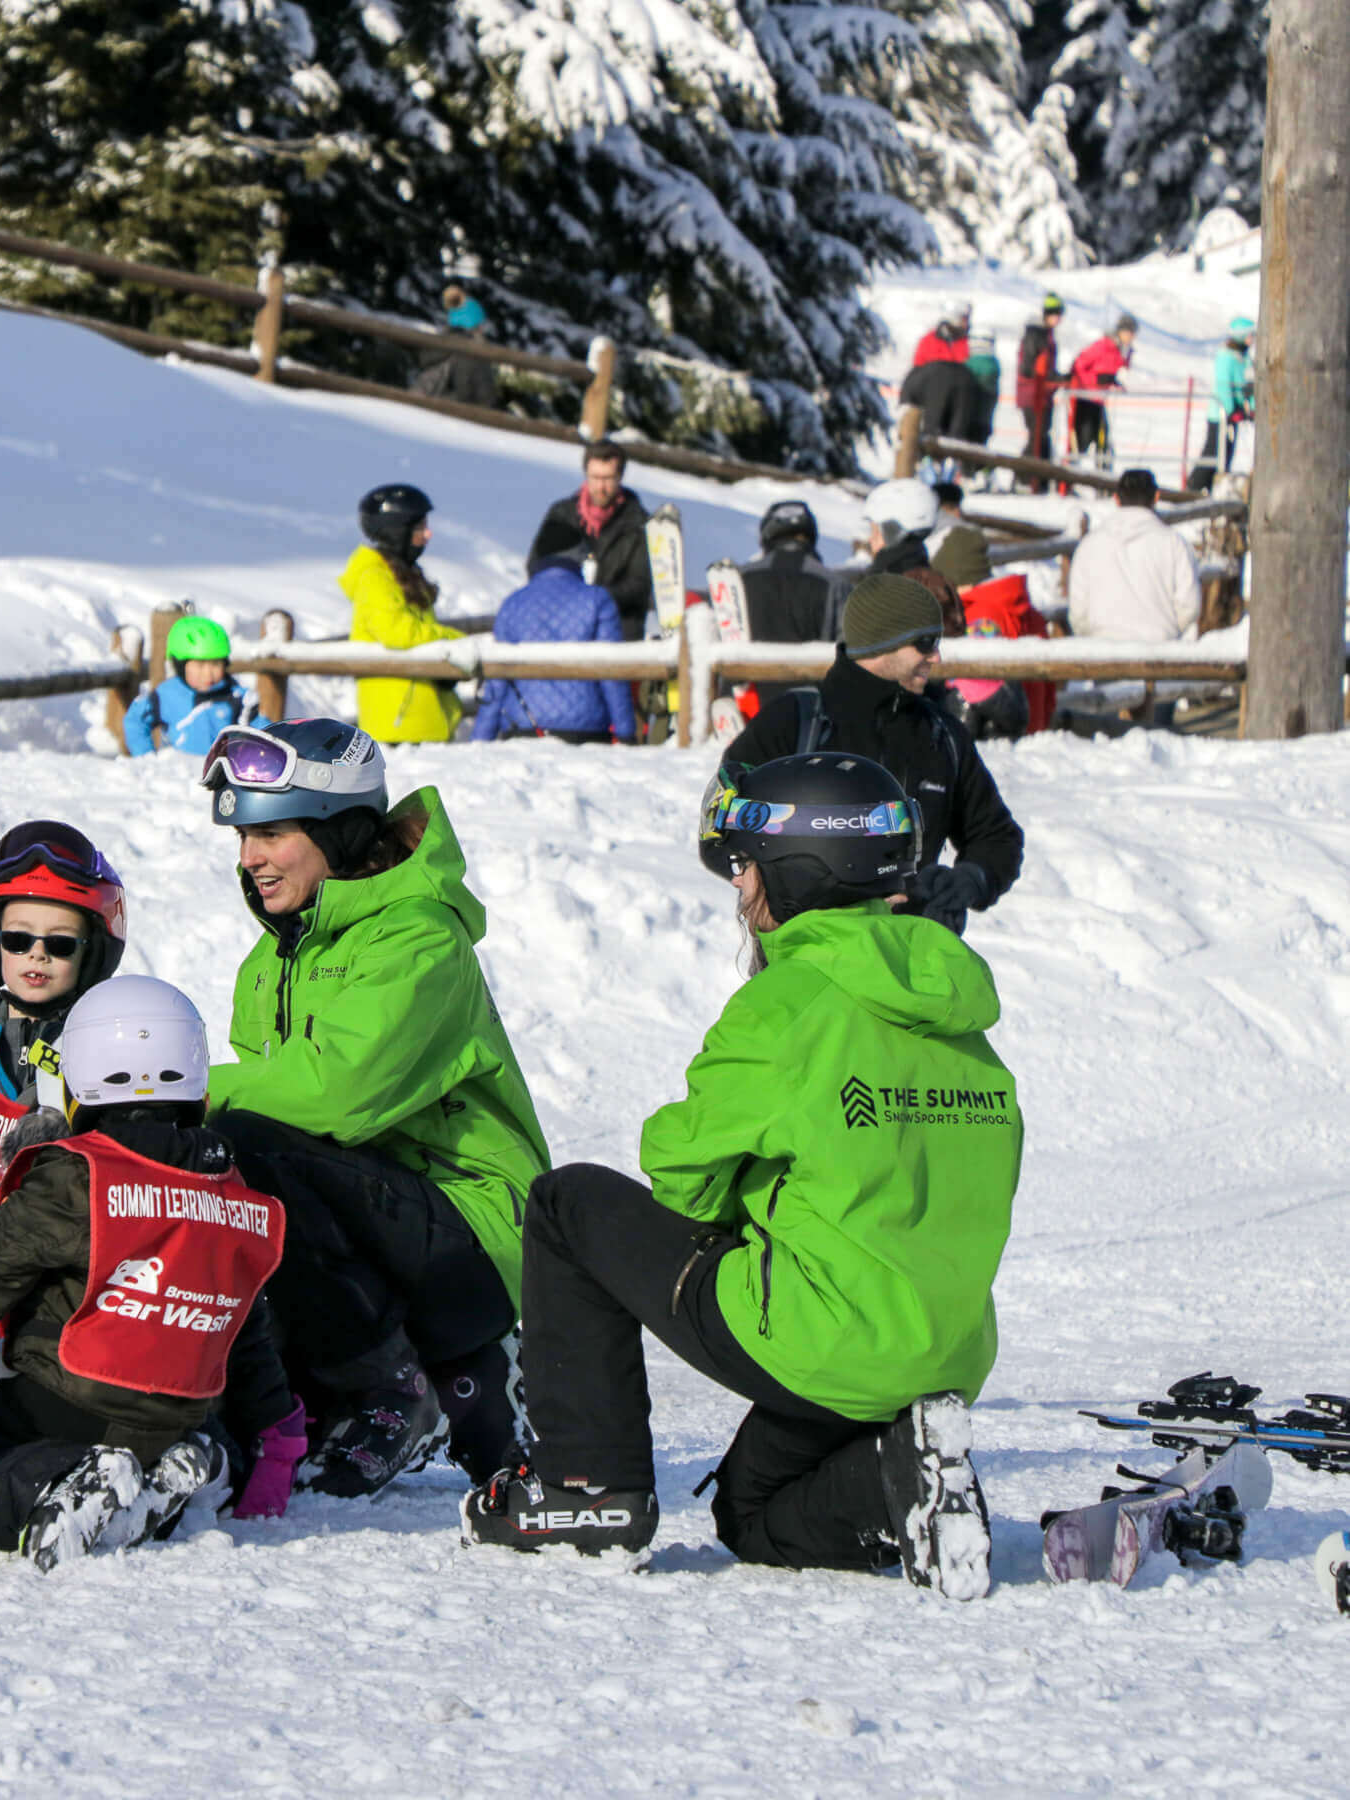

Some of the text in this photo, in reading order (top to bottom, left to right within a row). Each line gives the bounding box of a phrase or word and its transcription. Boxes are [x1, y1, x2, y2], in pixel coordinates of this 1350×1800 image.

[810, 814, 886, 830] electric
[879, 1088, 1007, 1109] THE SUMMIT
[107, 1183, 269, 1238] SUMMIT LEARNING CENTER
[164, 1286, 214, 1305] Brown
[96, 1290, 233, 1332] Car Wash
[518, 1509, 632, 1530] HEAD
